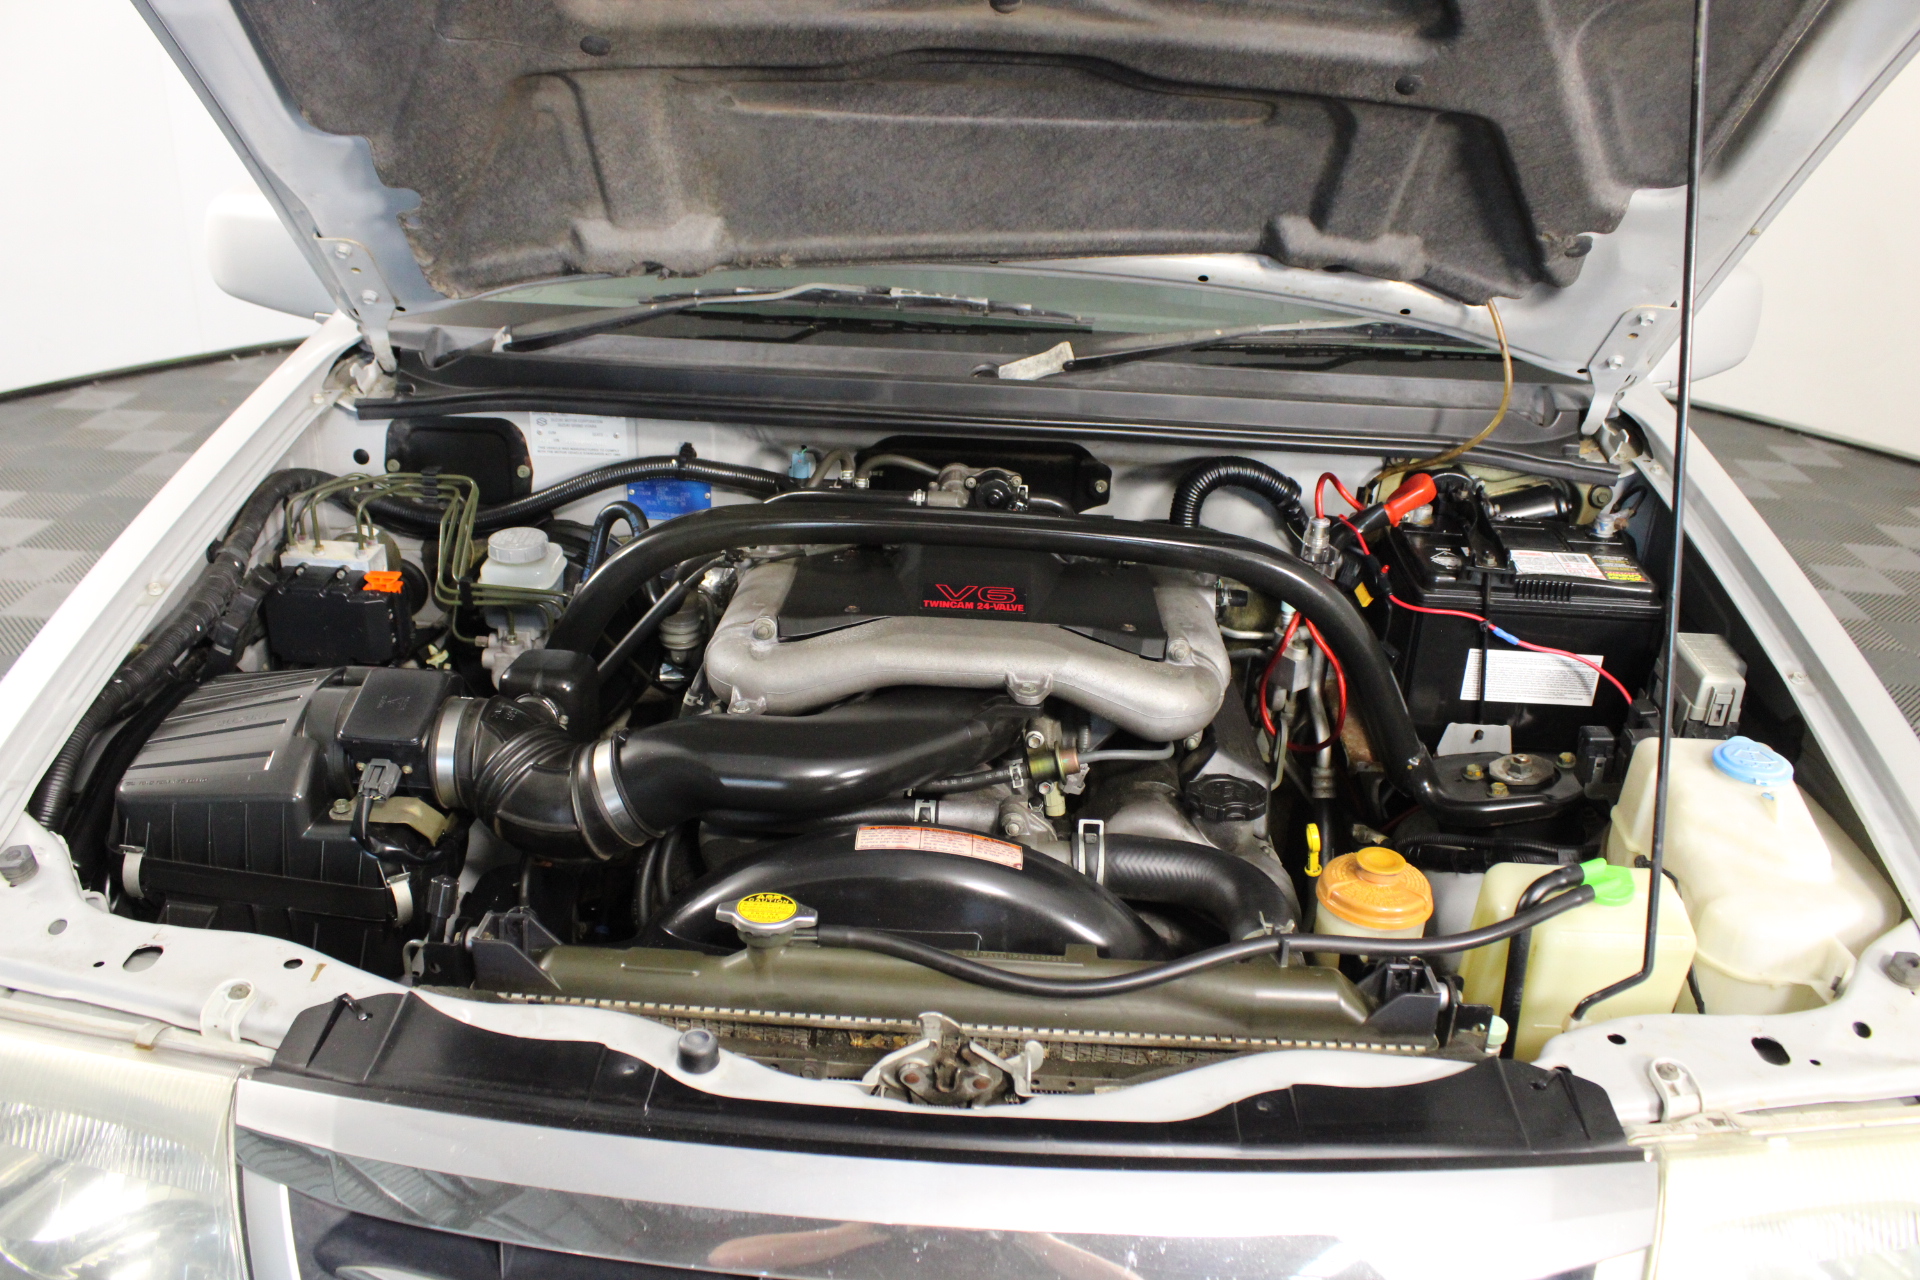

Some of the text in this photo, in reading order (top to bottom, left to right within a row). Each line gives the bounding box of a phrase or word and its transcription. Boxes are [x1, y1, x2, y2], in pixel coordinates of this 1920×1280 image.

[935, 583, 1017, 604] V6
[923, 599, 1025, 612] TWINCAM 24-VALVE
